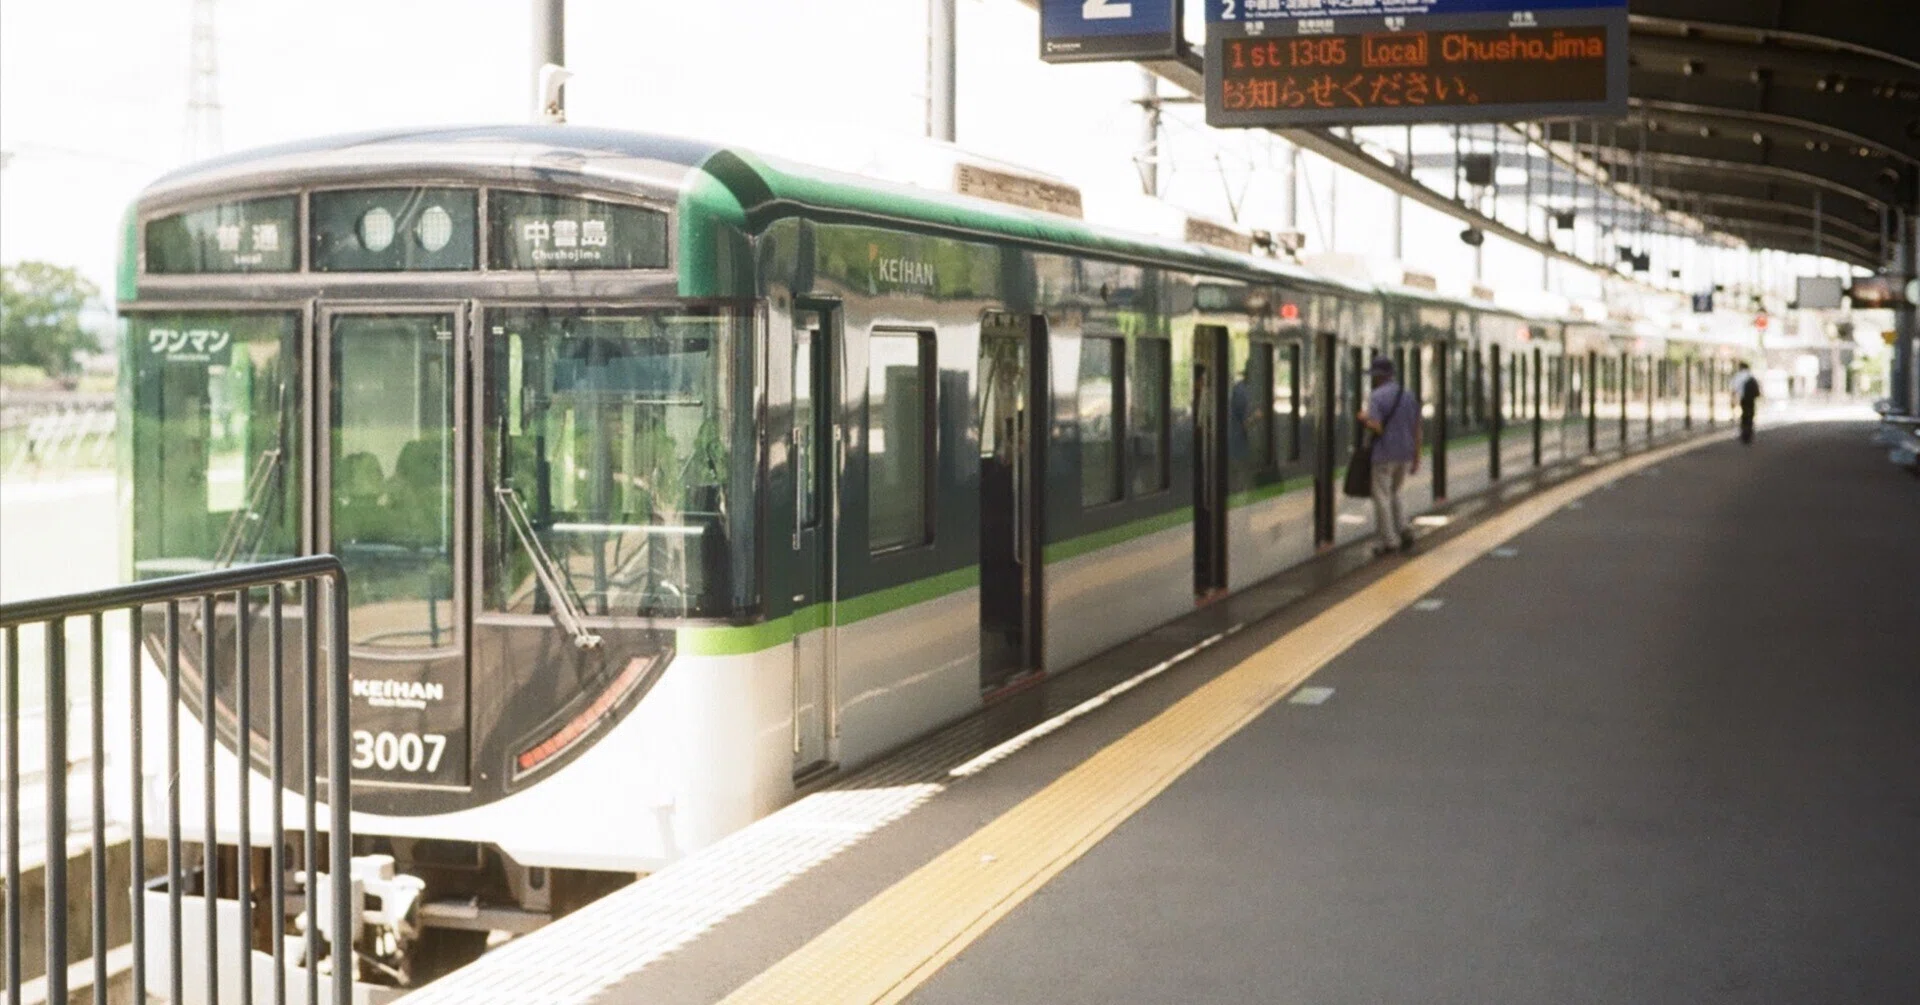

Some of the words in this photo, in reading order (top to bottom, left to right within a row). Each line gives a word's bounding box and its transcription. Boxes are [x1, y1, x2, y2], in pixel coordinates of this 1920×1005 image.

[1221, 0, 1236, 20] 2
[1290, 38, 1347, 67] 13:05
[1367, 36, 1422, 63] Local
[1442, 31, 1604, 61] Chushojima
[524, 220, 607, 248] 中書島
[531, 249, 601, 262] Chushojima
[879, 257, 934, 285] KEIHAN
[148, 330, 230, 352] ワンマン
[352, 679, 444, 700] KEIHAN
[351, 730, 447, 773] 3007
